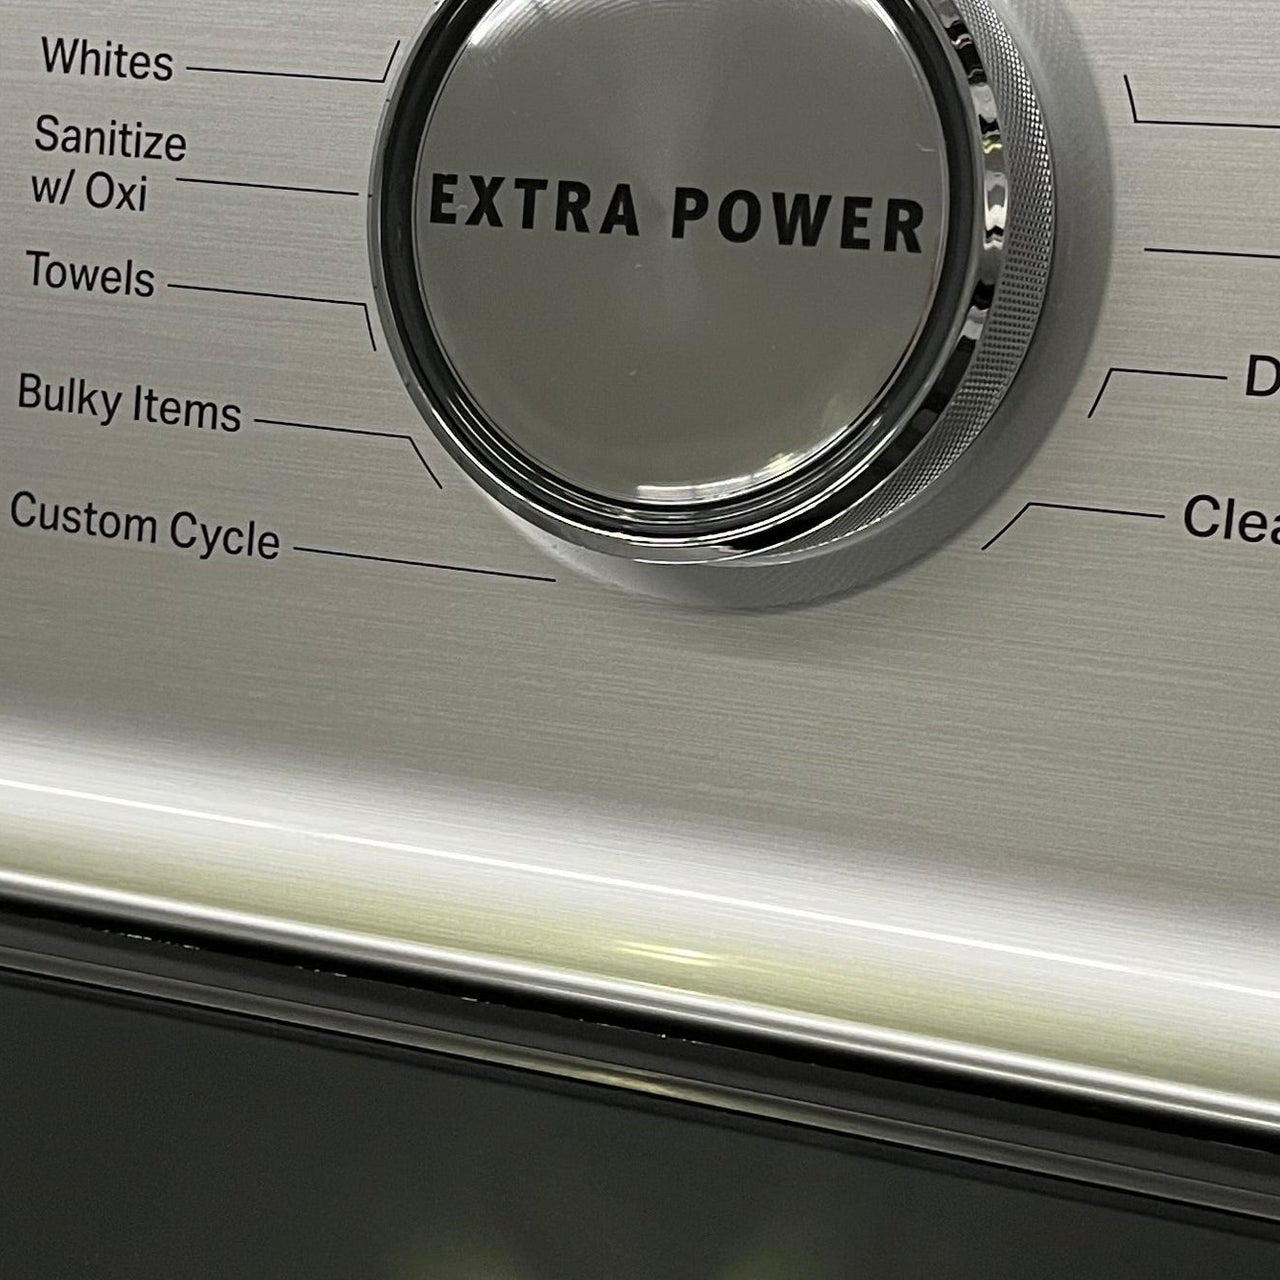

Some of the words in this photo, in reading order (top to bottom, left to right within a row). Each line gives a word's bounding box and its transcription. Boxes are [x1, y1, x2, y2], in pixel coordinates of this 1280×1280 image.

[40, 35, 175, 82] Whites
[33, 113, 188, 163] Sanitize
[31, 168, 76, 206] w/
[85, 170, 148, 213] Oxi
[429, 172, 641, 238] EXTRA
[671, 186, 926, 254] POWER
[25, 249, 156, 298] Towels
[18, 372, 123, 427] Bulky
[132, 384, 242, 433] Items
[10, 490, 157, 544] Custom
[169, 511, 282, 561] Cycle
